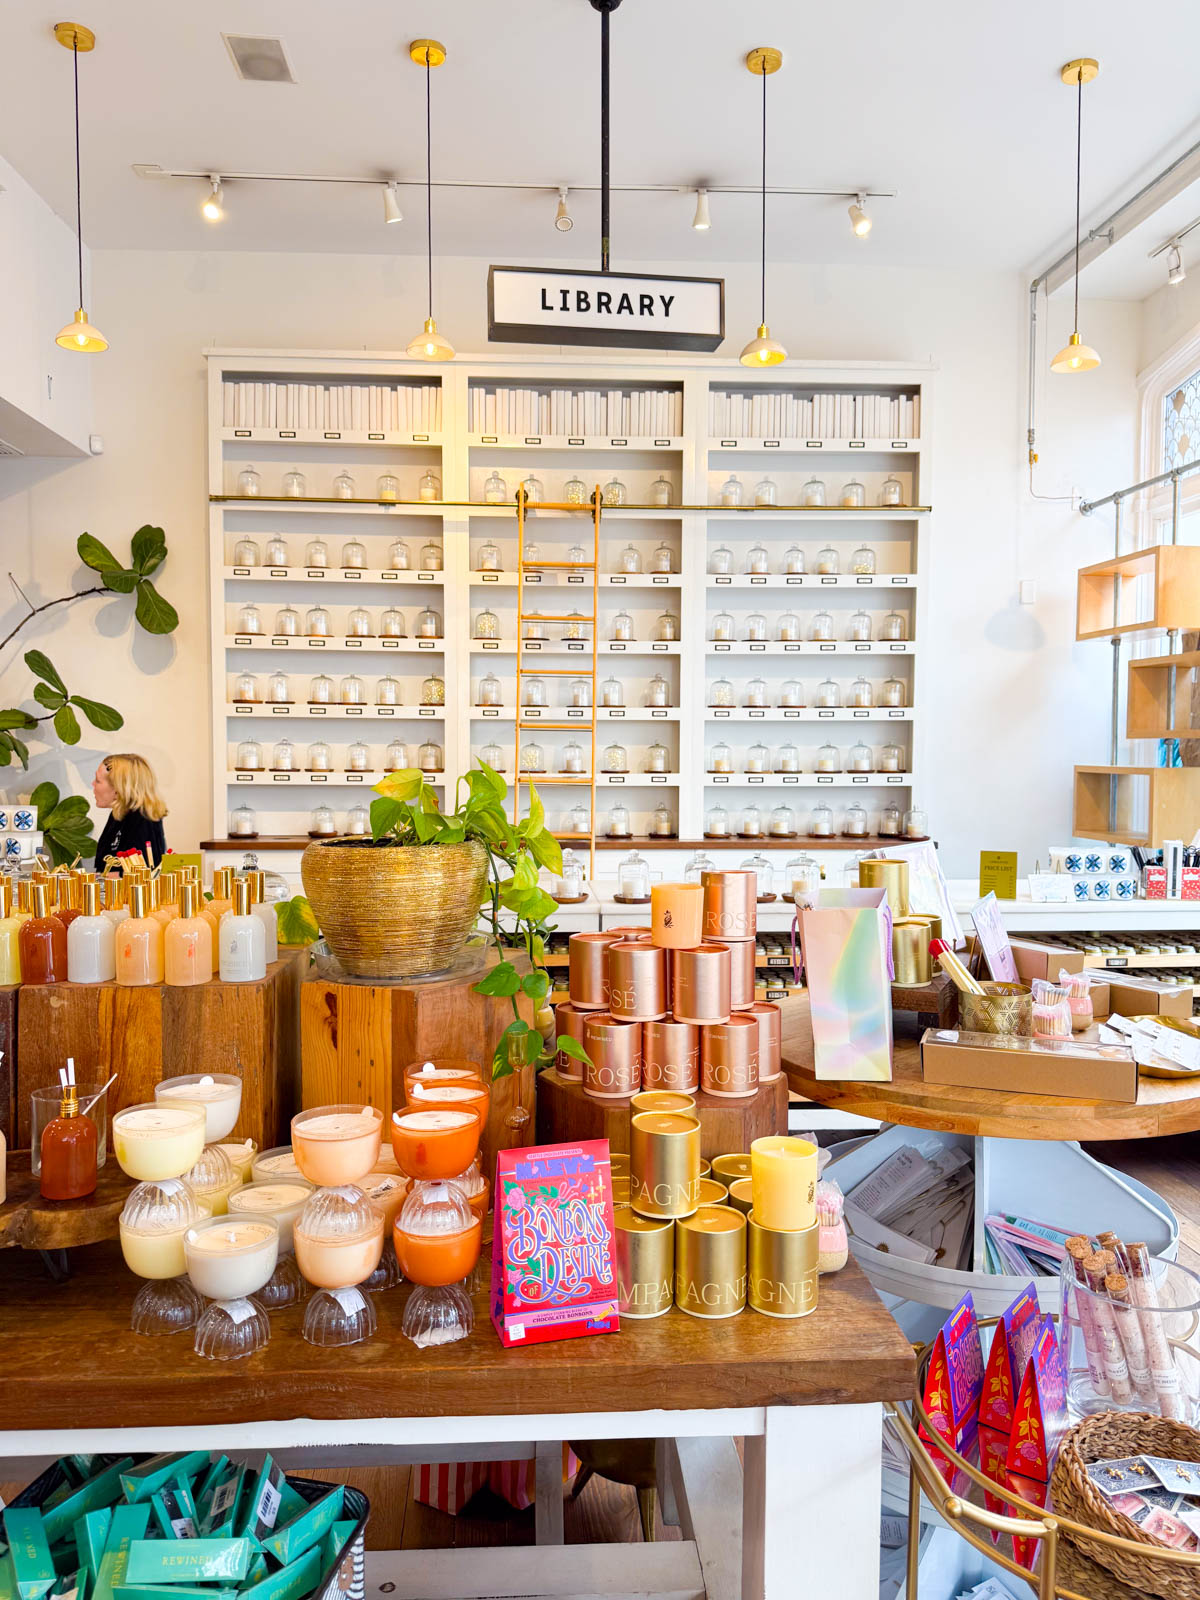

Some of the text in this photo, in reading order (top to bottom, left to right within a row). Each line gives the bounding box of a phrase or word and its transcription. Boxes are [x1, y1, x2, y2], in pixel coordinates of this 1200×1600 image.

[541, 288, 675, 317] LIBRARY
[586, 1059, 641, 1087] ROSÉ
[703, 1058, 757, 1085] ROSÉ
[505, 1199, 611, 1264] BONBONS
[514, 1242, 613, 1305] DESIRE
[529, 1285, 538, 1297] OF
[618, 1272, 674, 1305] MPA
[532, 1310, 593, 1323] CHOCOLATE BONBONS
